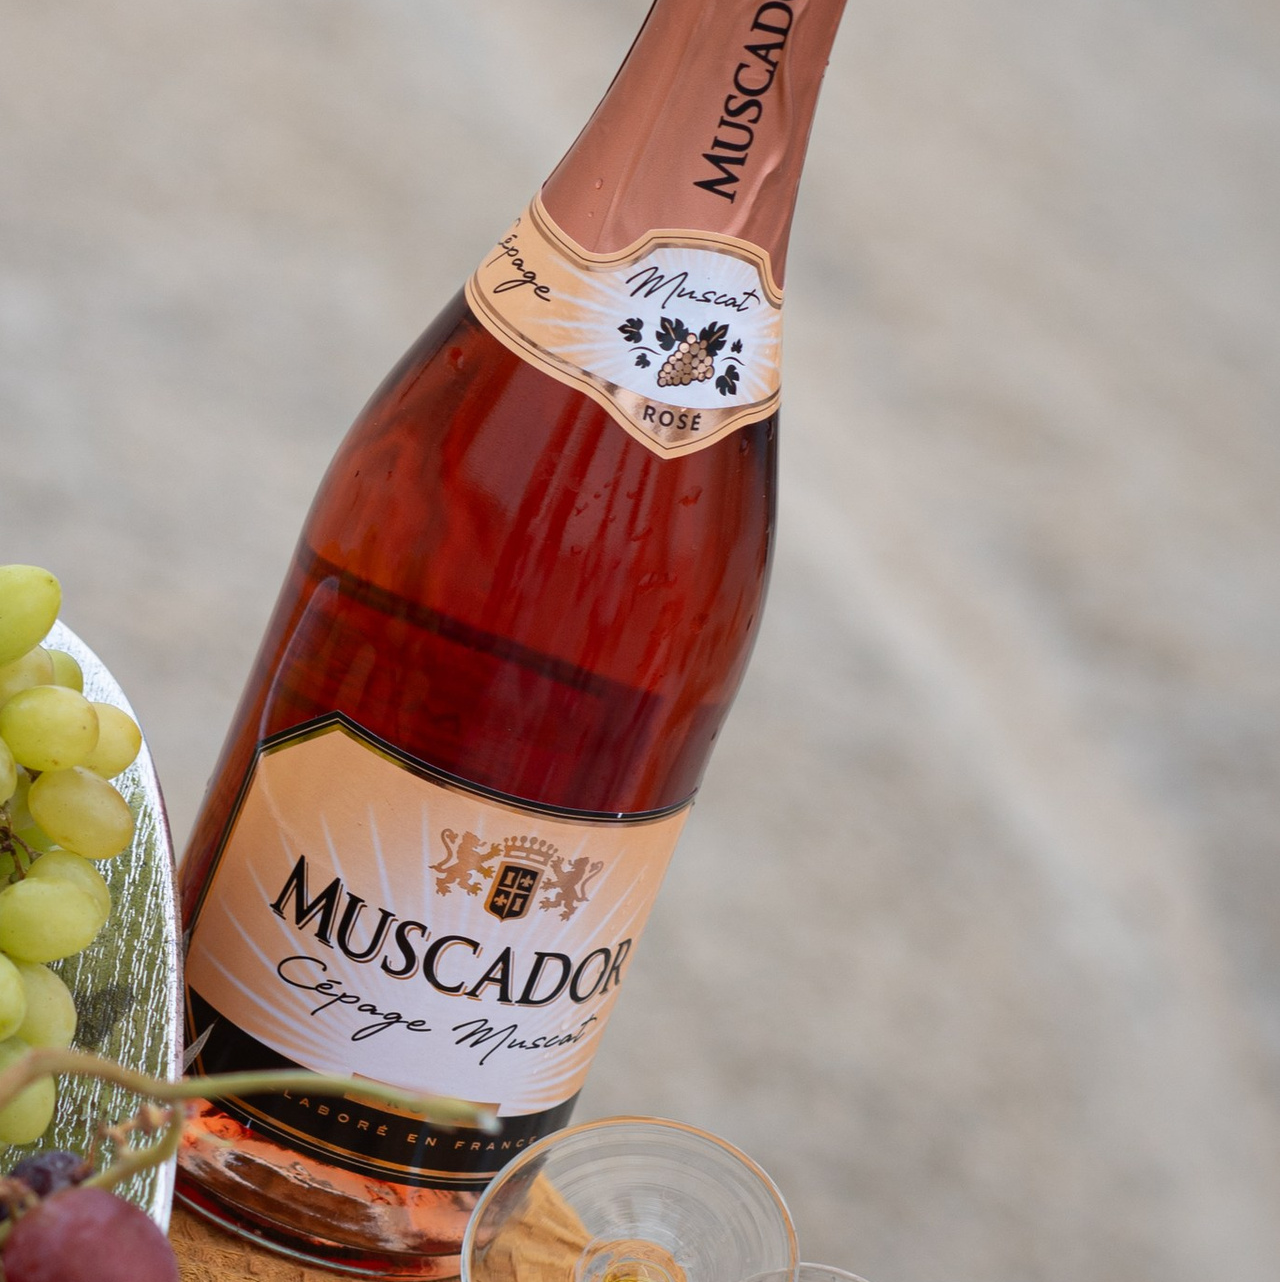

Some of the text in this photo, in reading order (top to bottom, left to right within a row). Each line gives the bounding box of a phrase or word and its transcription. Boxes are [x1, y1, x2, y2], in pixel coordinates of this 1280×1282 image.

[485, 217, 760, 312] épage Muscat
[642, 404, 703, 432] ROSÉ
[269, 855, 632, 1007] MUSCADOR
[276, 955, 598, 1065] Cépage Muscat
[270, 1085, 388, 1137] LABORÉ
[406, 1133, 439, 1147] EN
[454, 1135, 537, 1151] FRANCE
